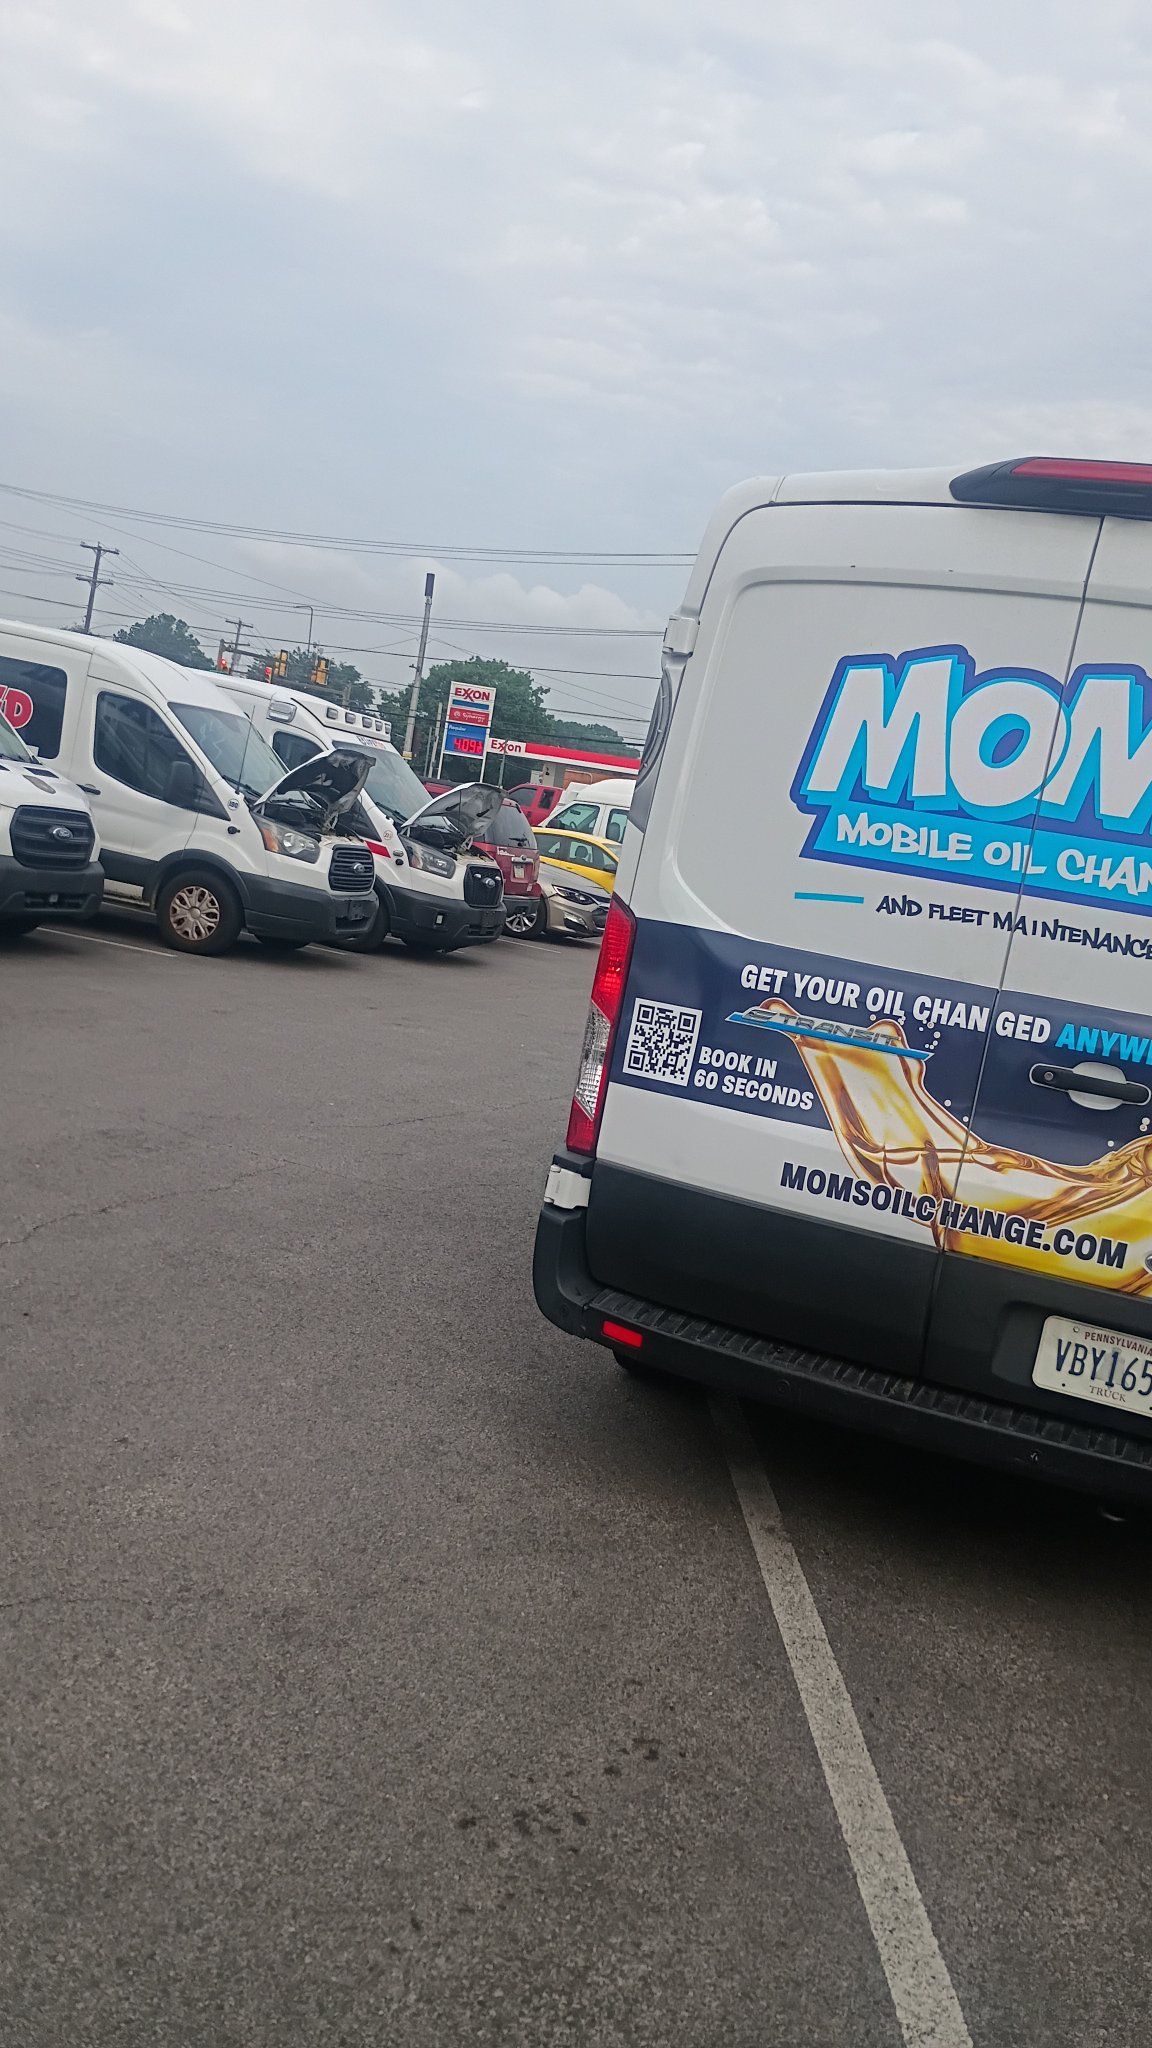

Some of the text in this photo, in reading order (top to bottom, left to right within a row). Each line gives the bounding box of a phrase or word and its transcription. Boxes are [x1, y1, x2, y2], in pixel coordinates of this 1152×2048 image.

[454, 687, 491, 702] EXXON
[836, 812, 974, 862] MOBILE
[983, 841, 1048, 875] OIL
[876, 894, 922, 917] AND
[928, 903, 990, 926] FLEET
[740, 964, 788, 994] GET
[793, 972, 862, 1009] YOUR
[866, 987, 906, 1017] OIL
[1055, 1023, 1152, 1066] ANYW
[699, 1046, 778, 1079] BOOK IN
[693, 1068, 815, 1111] 60 SECONDS
[779, 1161, 1129, 1270] MOMSOILCHANGE.COM
[1084, 1331, 1152, 1357] PENNSYLVANIA
[1089, 1385, 1127, 1403] TRUCK
